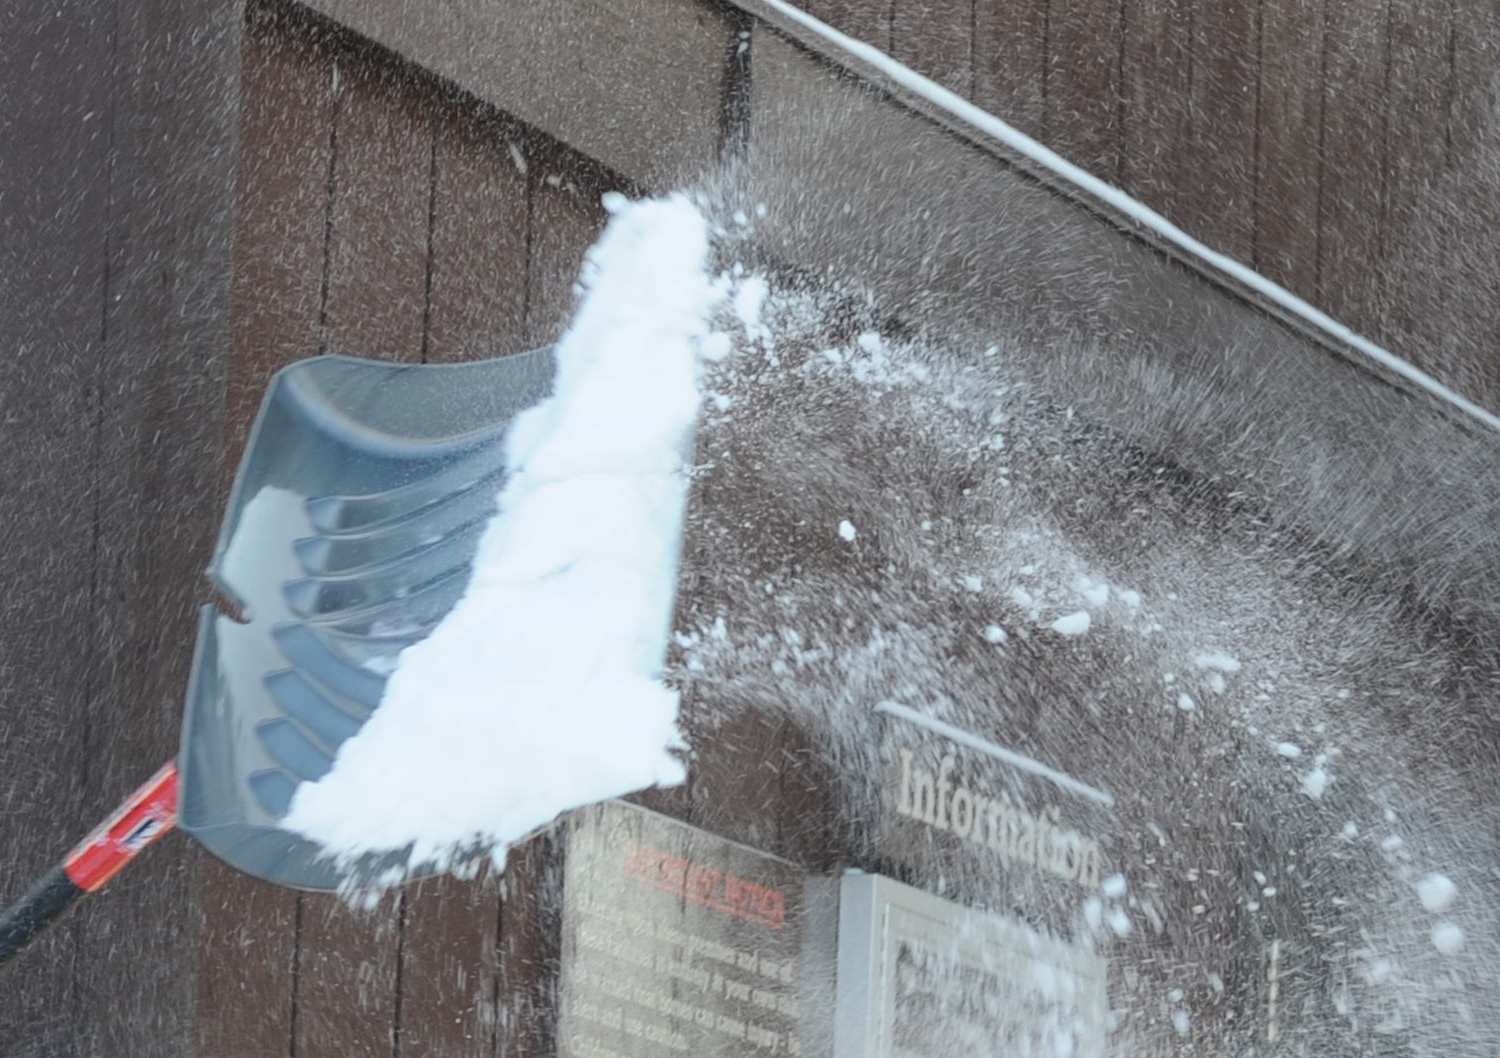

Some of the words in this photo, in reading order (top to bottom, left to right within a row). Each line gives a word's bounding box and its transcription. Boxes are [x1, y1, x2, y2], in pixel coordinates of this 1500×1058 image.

[896, 749, 1100, 889] Information
[737, 944, 758, 972] and
[694, 1007, 713, 1029] can
